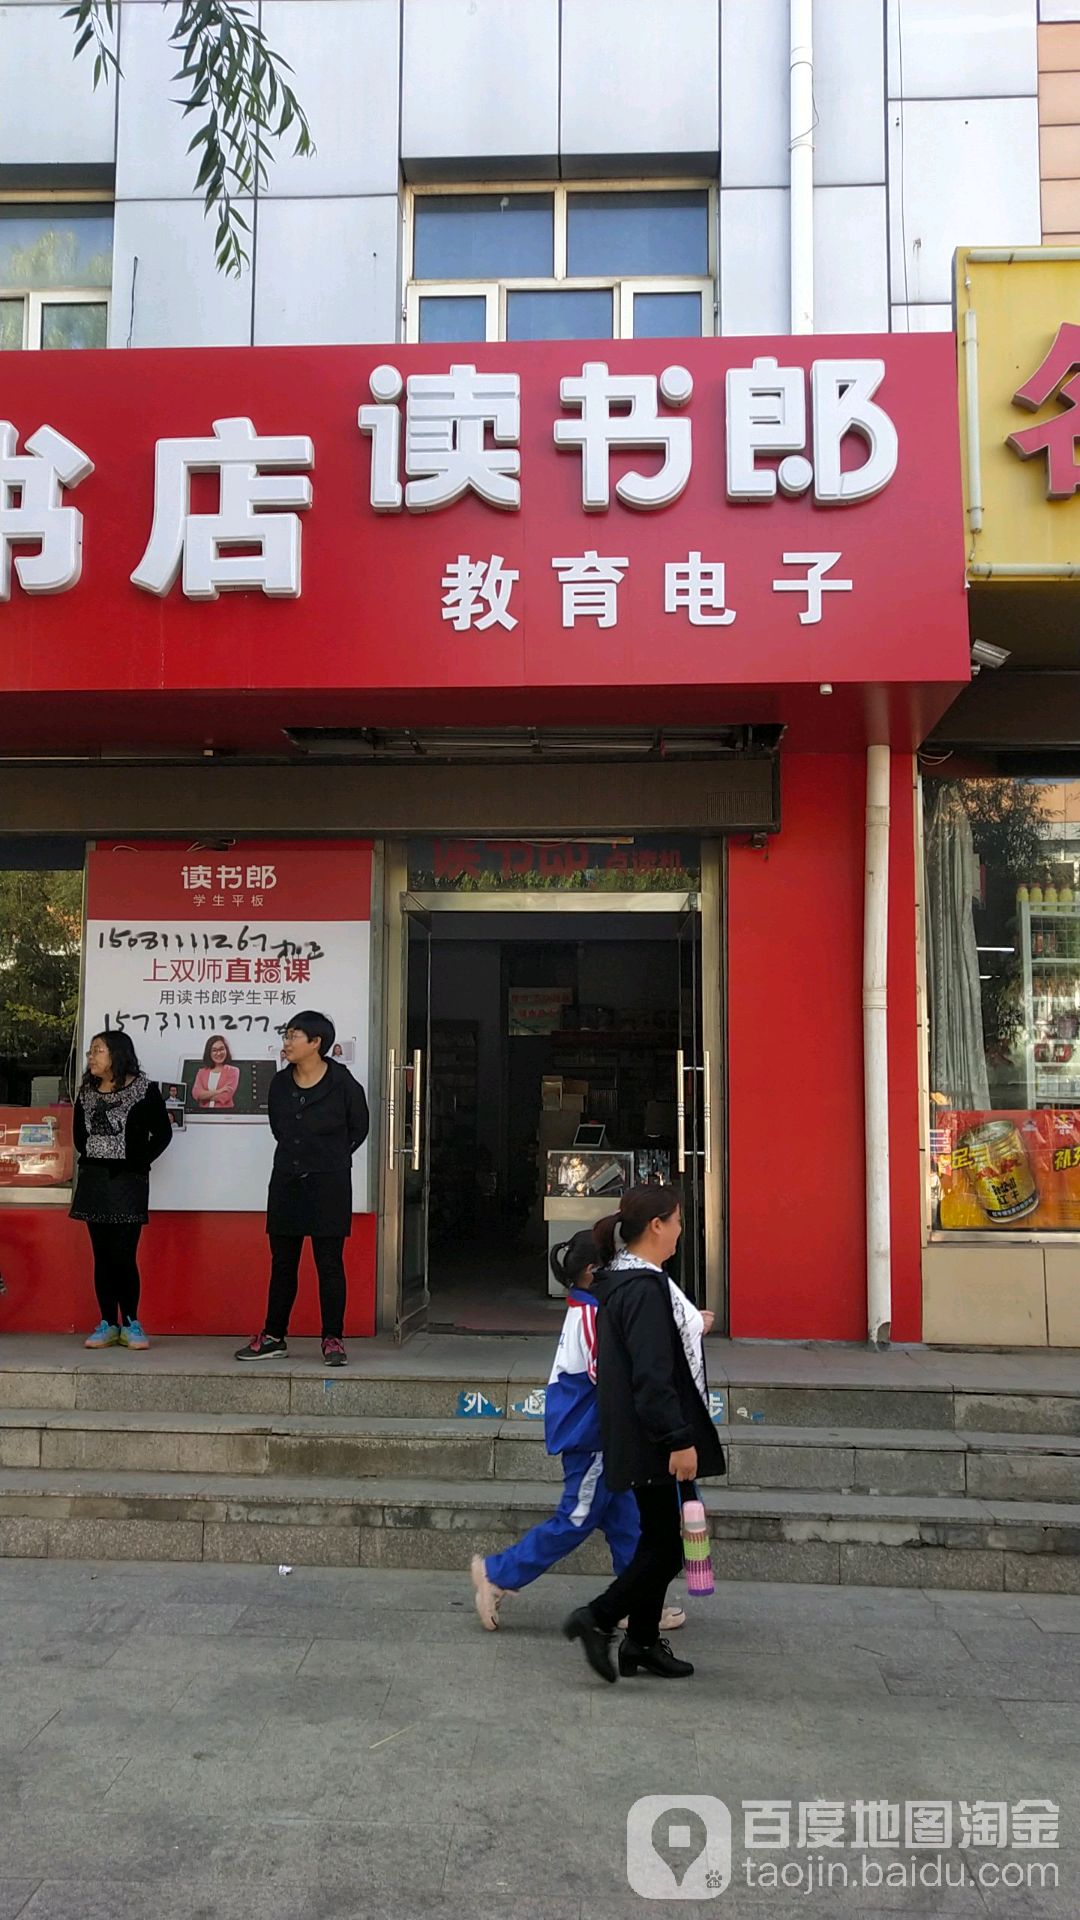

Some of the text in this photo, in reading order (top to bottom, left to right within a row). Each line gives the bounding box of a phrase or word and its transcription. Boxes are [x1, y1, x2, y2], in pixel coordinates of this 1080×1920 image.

[358, 356, 898, 513] 读书郎
[441, 550, 853, 632] 教育电子
[181, 865, 277, 889] 读书郎
[193, 894, 264, 907] 学生平板
[143, 957, 311, 984] 上双师直播课
[159, 989, 297, 1006] 用读书郎学生平板
